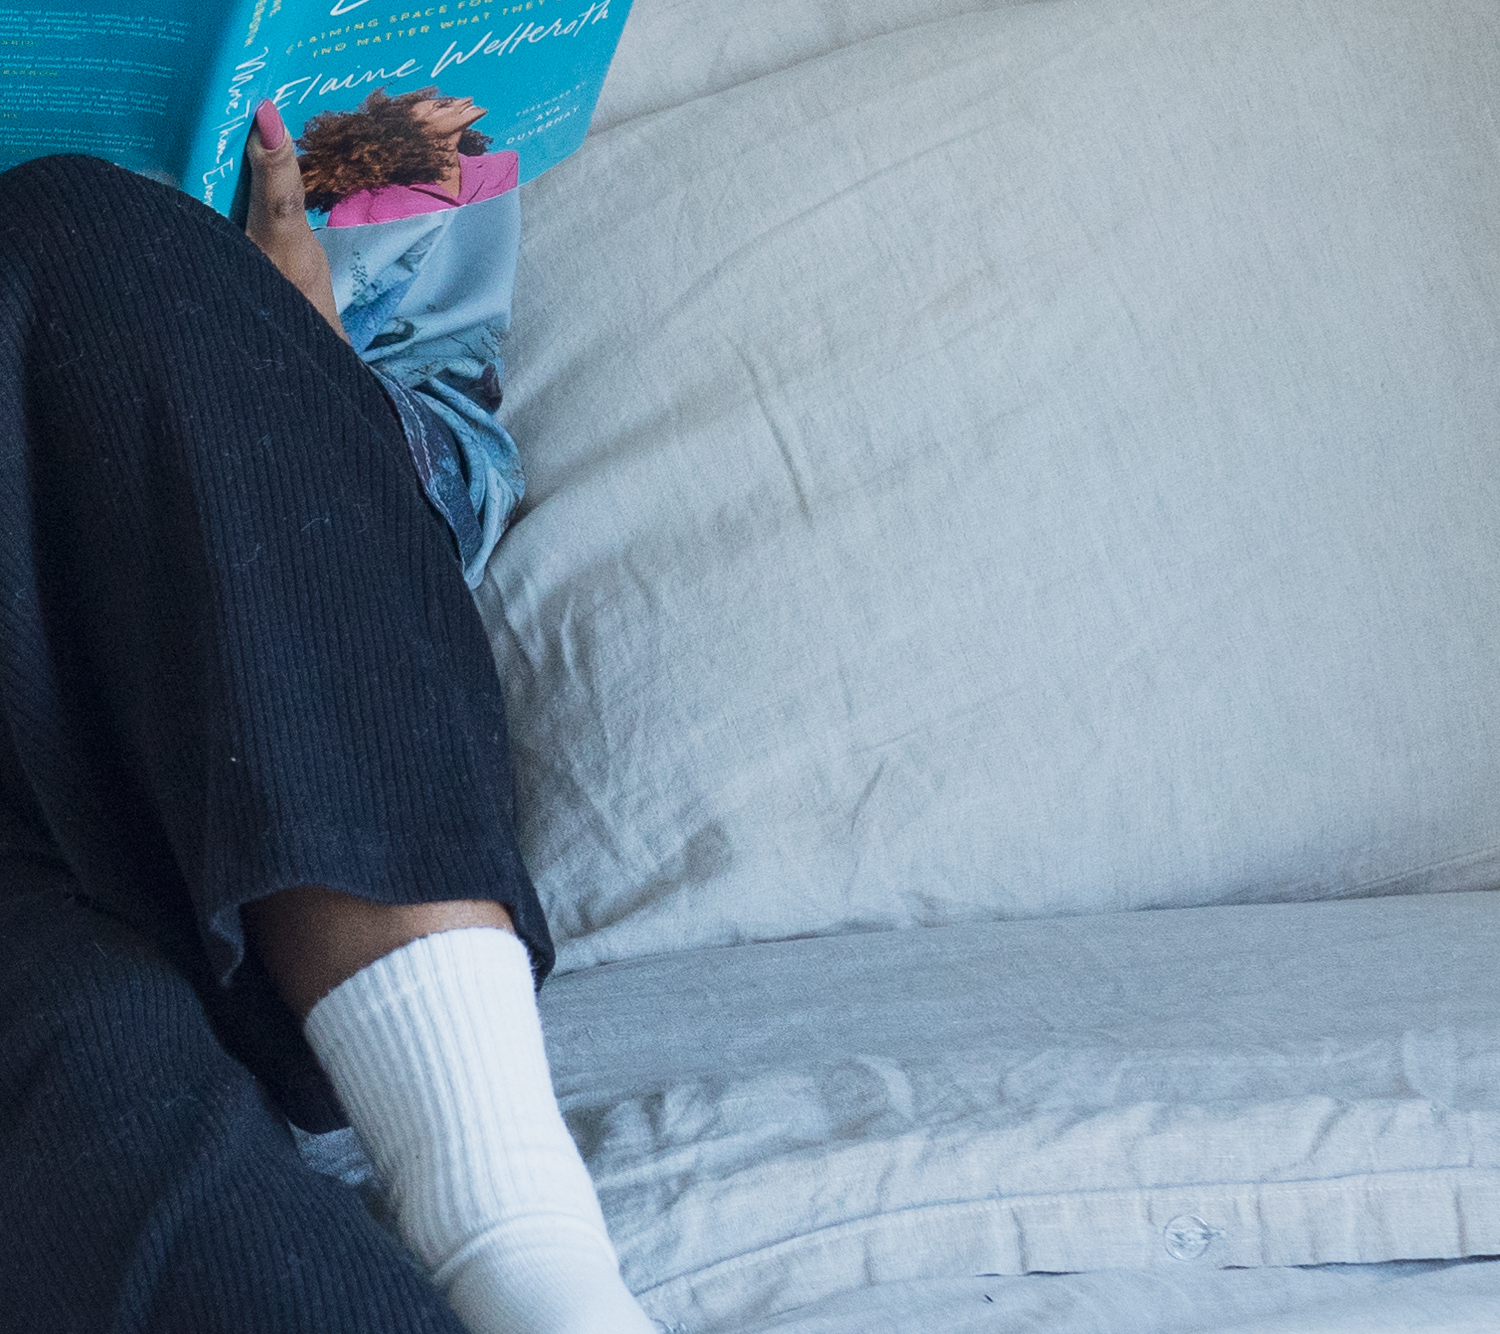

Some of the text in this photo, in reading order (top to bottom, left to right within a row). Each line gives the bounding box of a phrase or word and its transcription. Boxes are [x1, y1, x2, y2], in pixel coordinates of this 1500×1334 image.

[356, 24, 430, 47] MATTER
[440, 12, 490, 29] WHAT
[390, 4, 447, 23] SPACE
[272, 58, 424, 111] Elaine
[211, 100, 250, 164] Than
[506, 104, 580, 145] DUVERNAY
[535, 105, 560, 122] AVA
